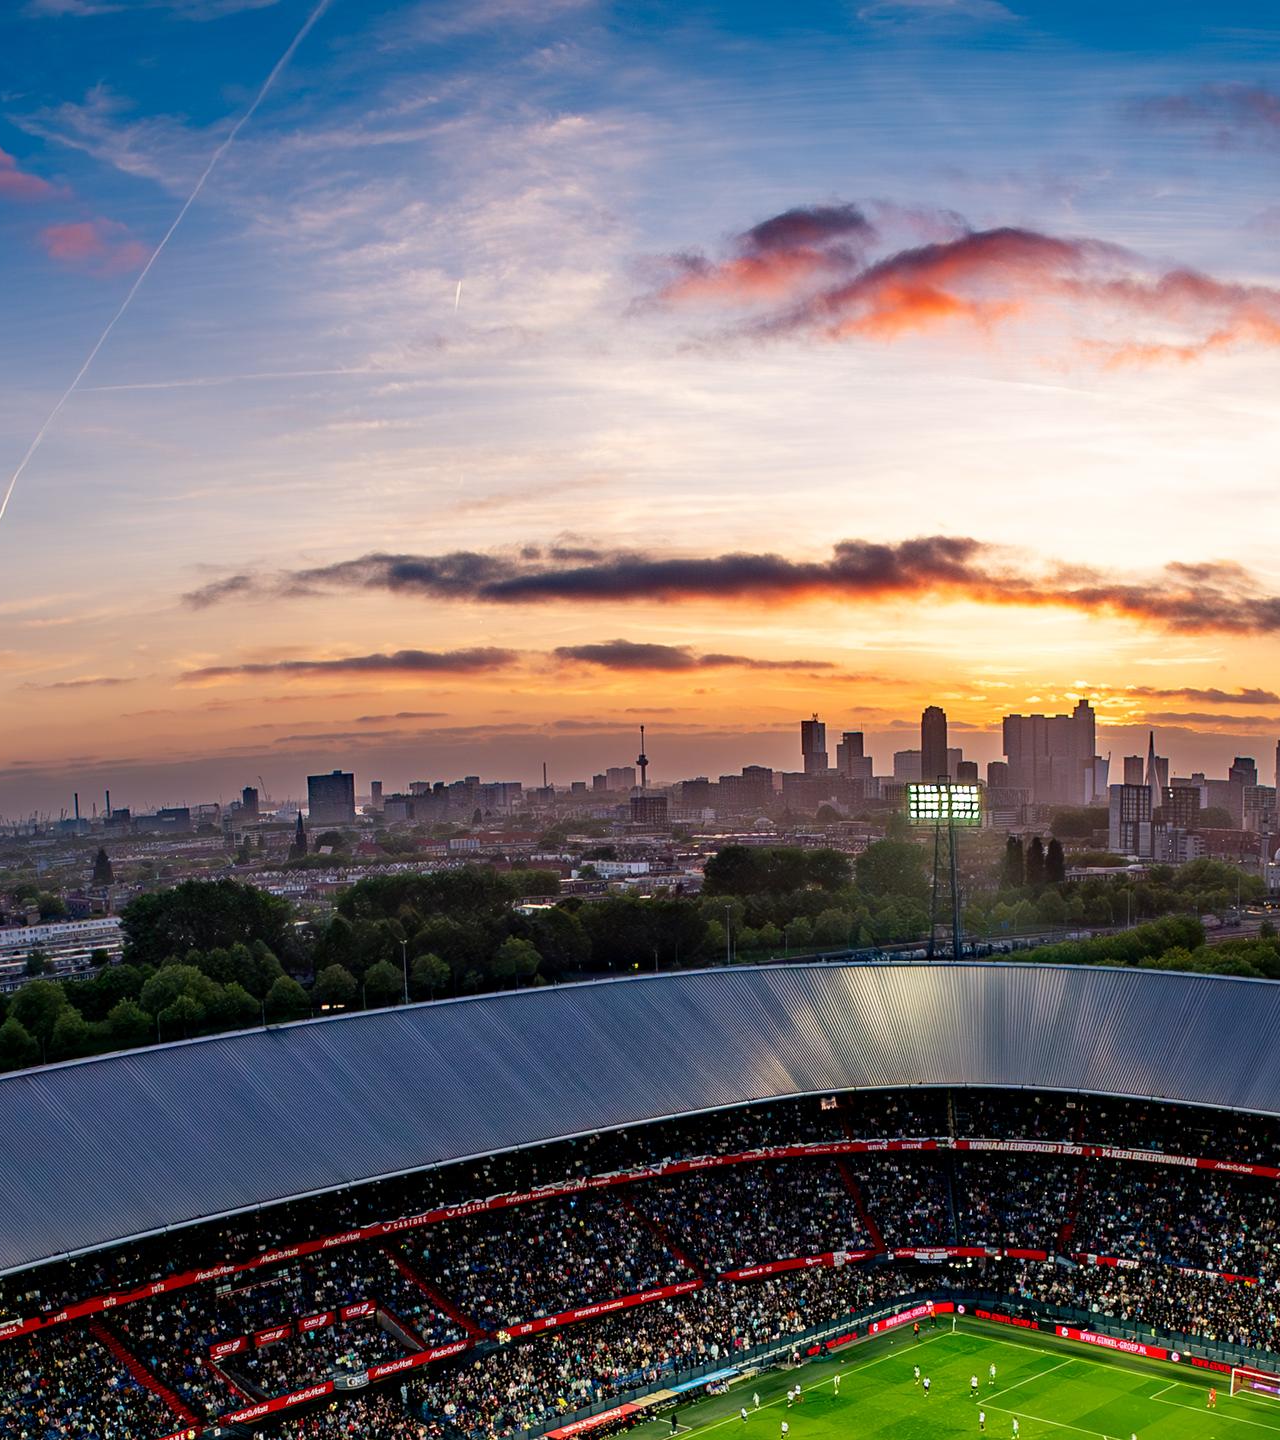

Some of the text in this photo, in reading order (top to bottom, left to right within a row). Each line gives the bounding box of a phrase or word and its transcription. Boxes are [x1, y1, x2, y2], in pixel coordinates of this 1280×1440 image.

[969, 1141, 1009, 1151] WINNAAR
[1062, 1145, 1083, 1156] 1970
[1132, 1152, 1198, 1167] BEKERWINNAAR
[458, 1202, 491, 1215] CASTORE
[394, 1216, 428, 1229] CASTORE
[1080, 1331, 1147, 1355] WWW.GINKEL-GROEP.NL
